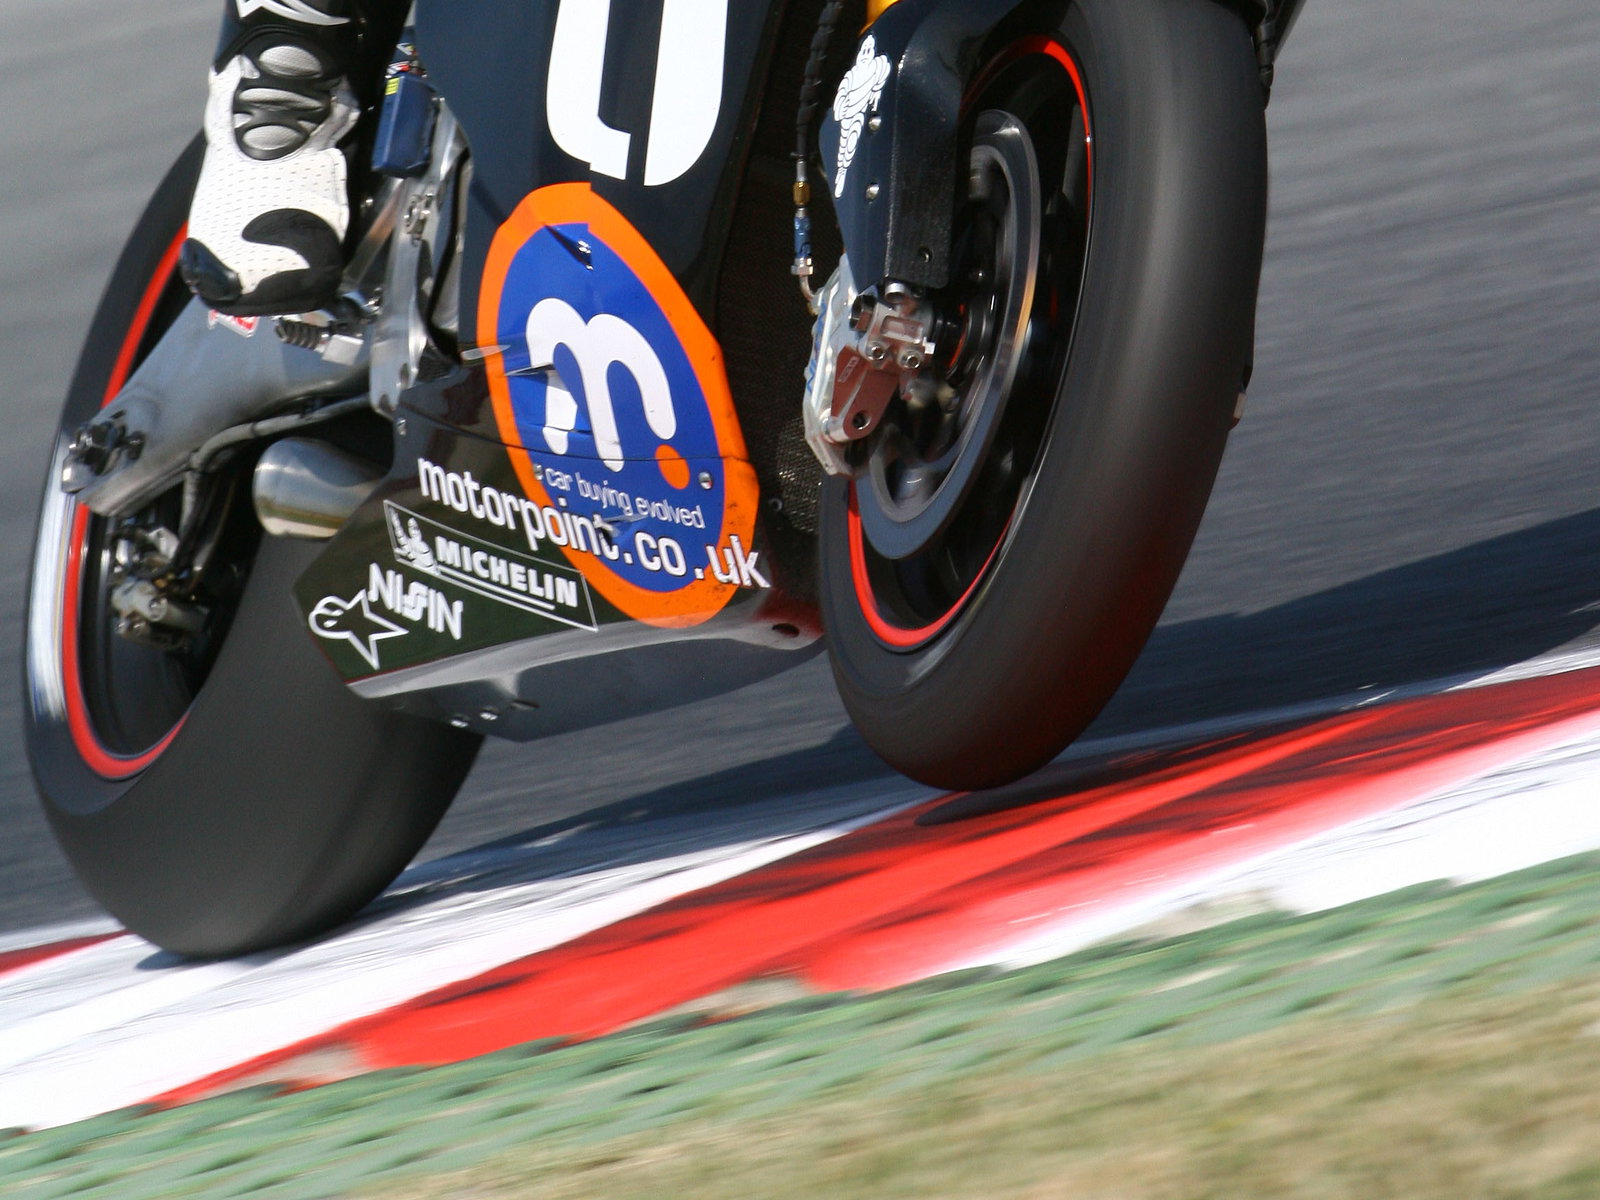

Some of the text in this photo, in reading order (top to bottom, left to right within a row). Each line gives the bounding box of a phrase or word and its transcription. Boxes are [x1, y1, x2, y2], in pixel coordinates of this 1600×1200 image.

[545, 468, 706, 530] car buying evolved
[368, 562, 463, 640] NISSIN
[434, 535, 579, 608] MICHELIN
